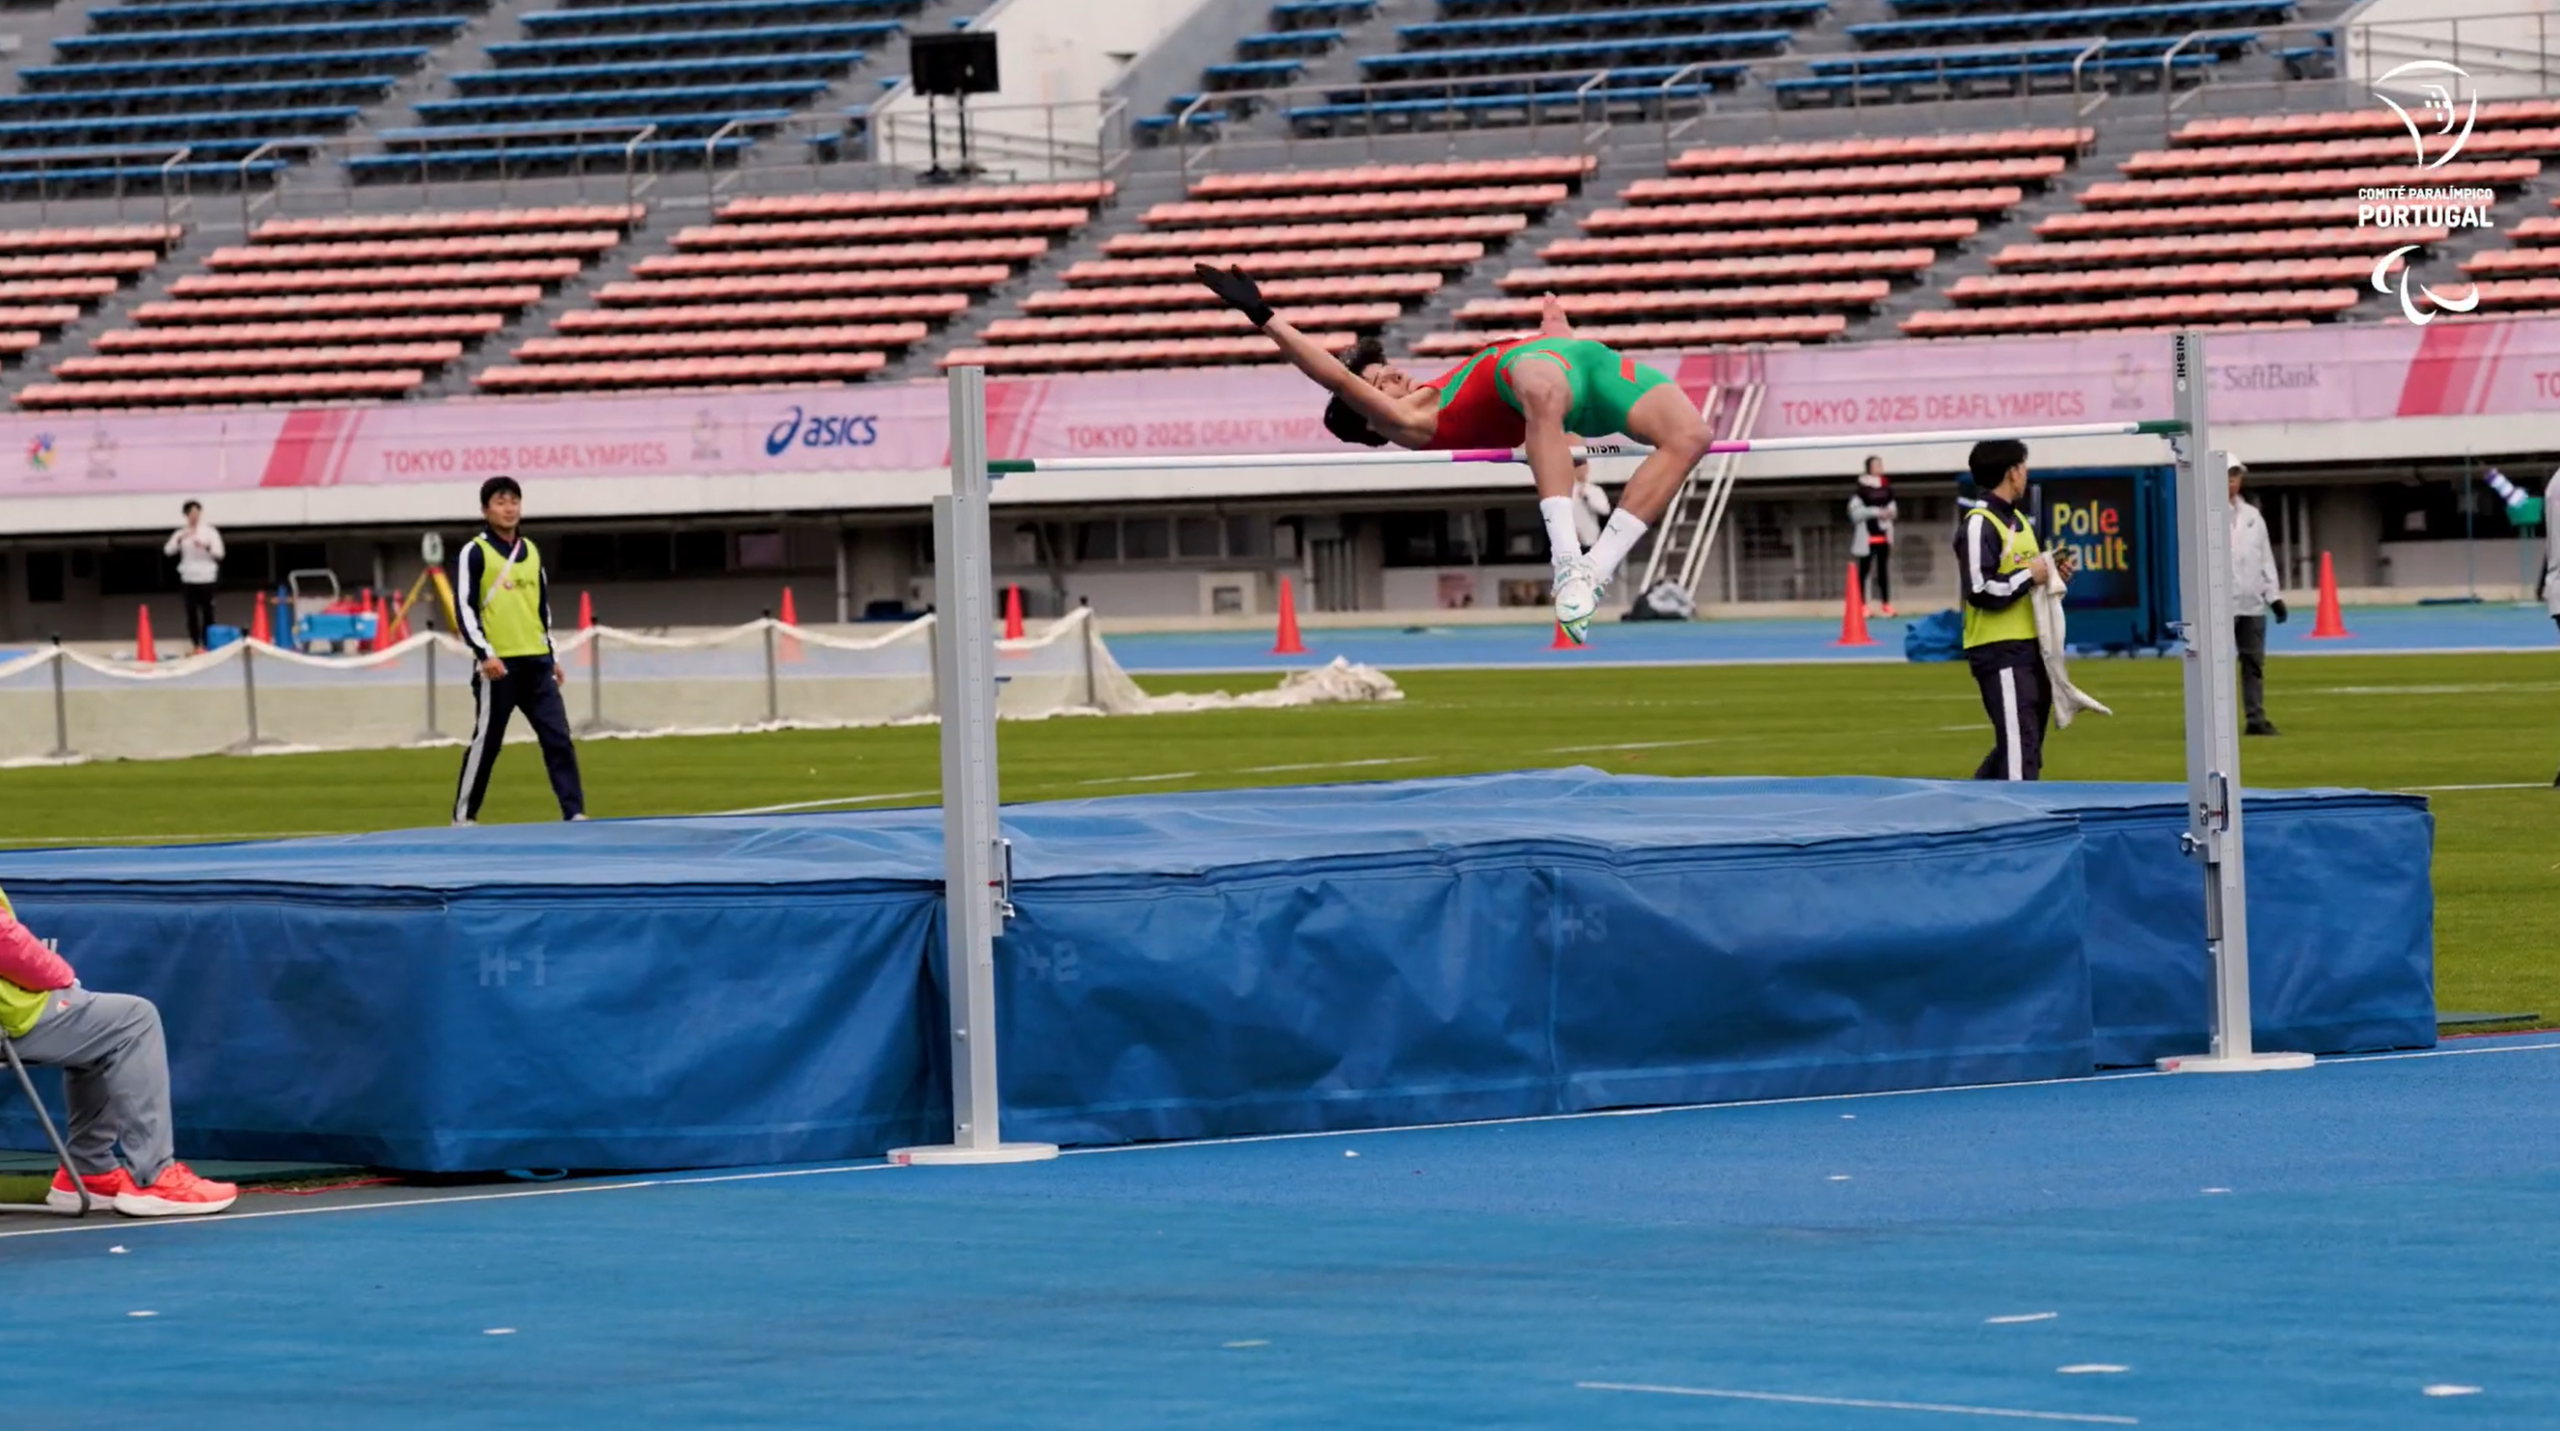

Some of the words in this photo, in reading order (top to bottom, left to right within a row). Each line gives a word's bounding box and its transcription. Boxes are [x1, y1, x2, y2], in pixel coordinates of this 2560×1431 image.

[2176, 335, 2186, 378] NISHI
[2224, 363, 2319, 391] SoftBank
[1782, 398, 1859, 426] TOKYO
[1865, 395, 1919, 423] 2025
[1926, 390, 2086, 419] DEAFLYMPICS
[1067, 425, 1138, 449] TOKYO
[1145, 421, 1195, 447] 2025
[383, 450, 455, 474] TOKYO
[460, 445, 511, 471] 2025
[517, 442, 668, 469] DEAFLYMPICS
[2053, 501, 2119, 535] Pole
